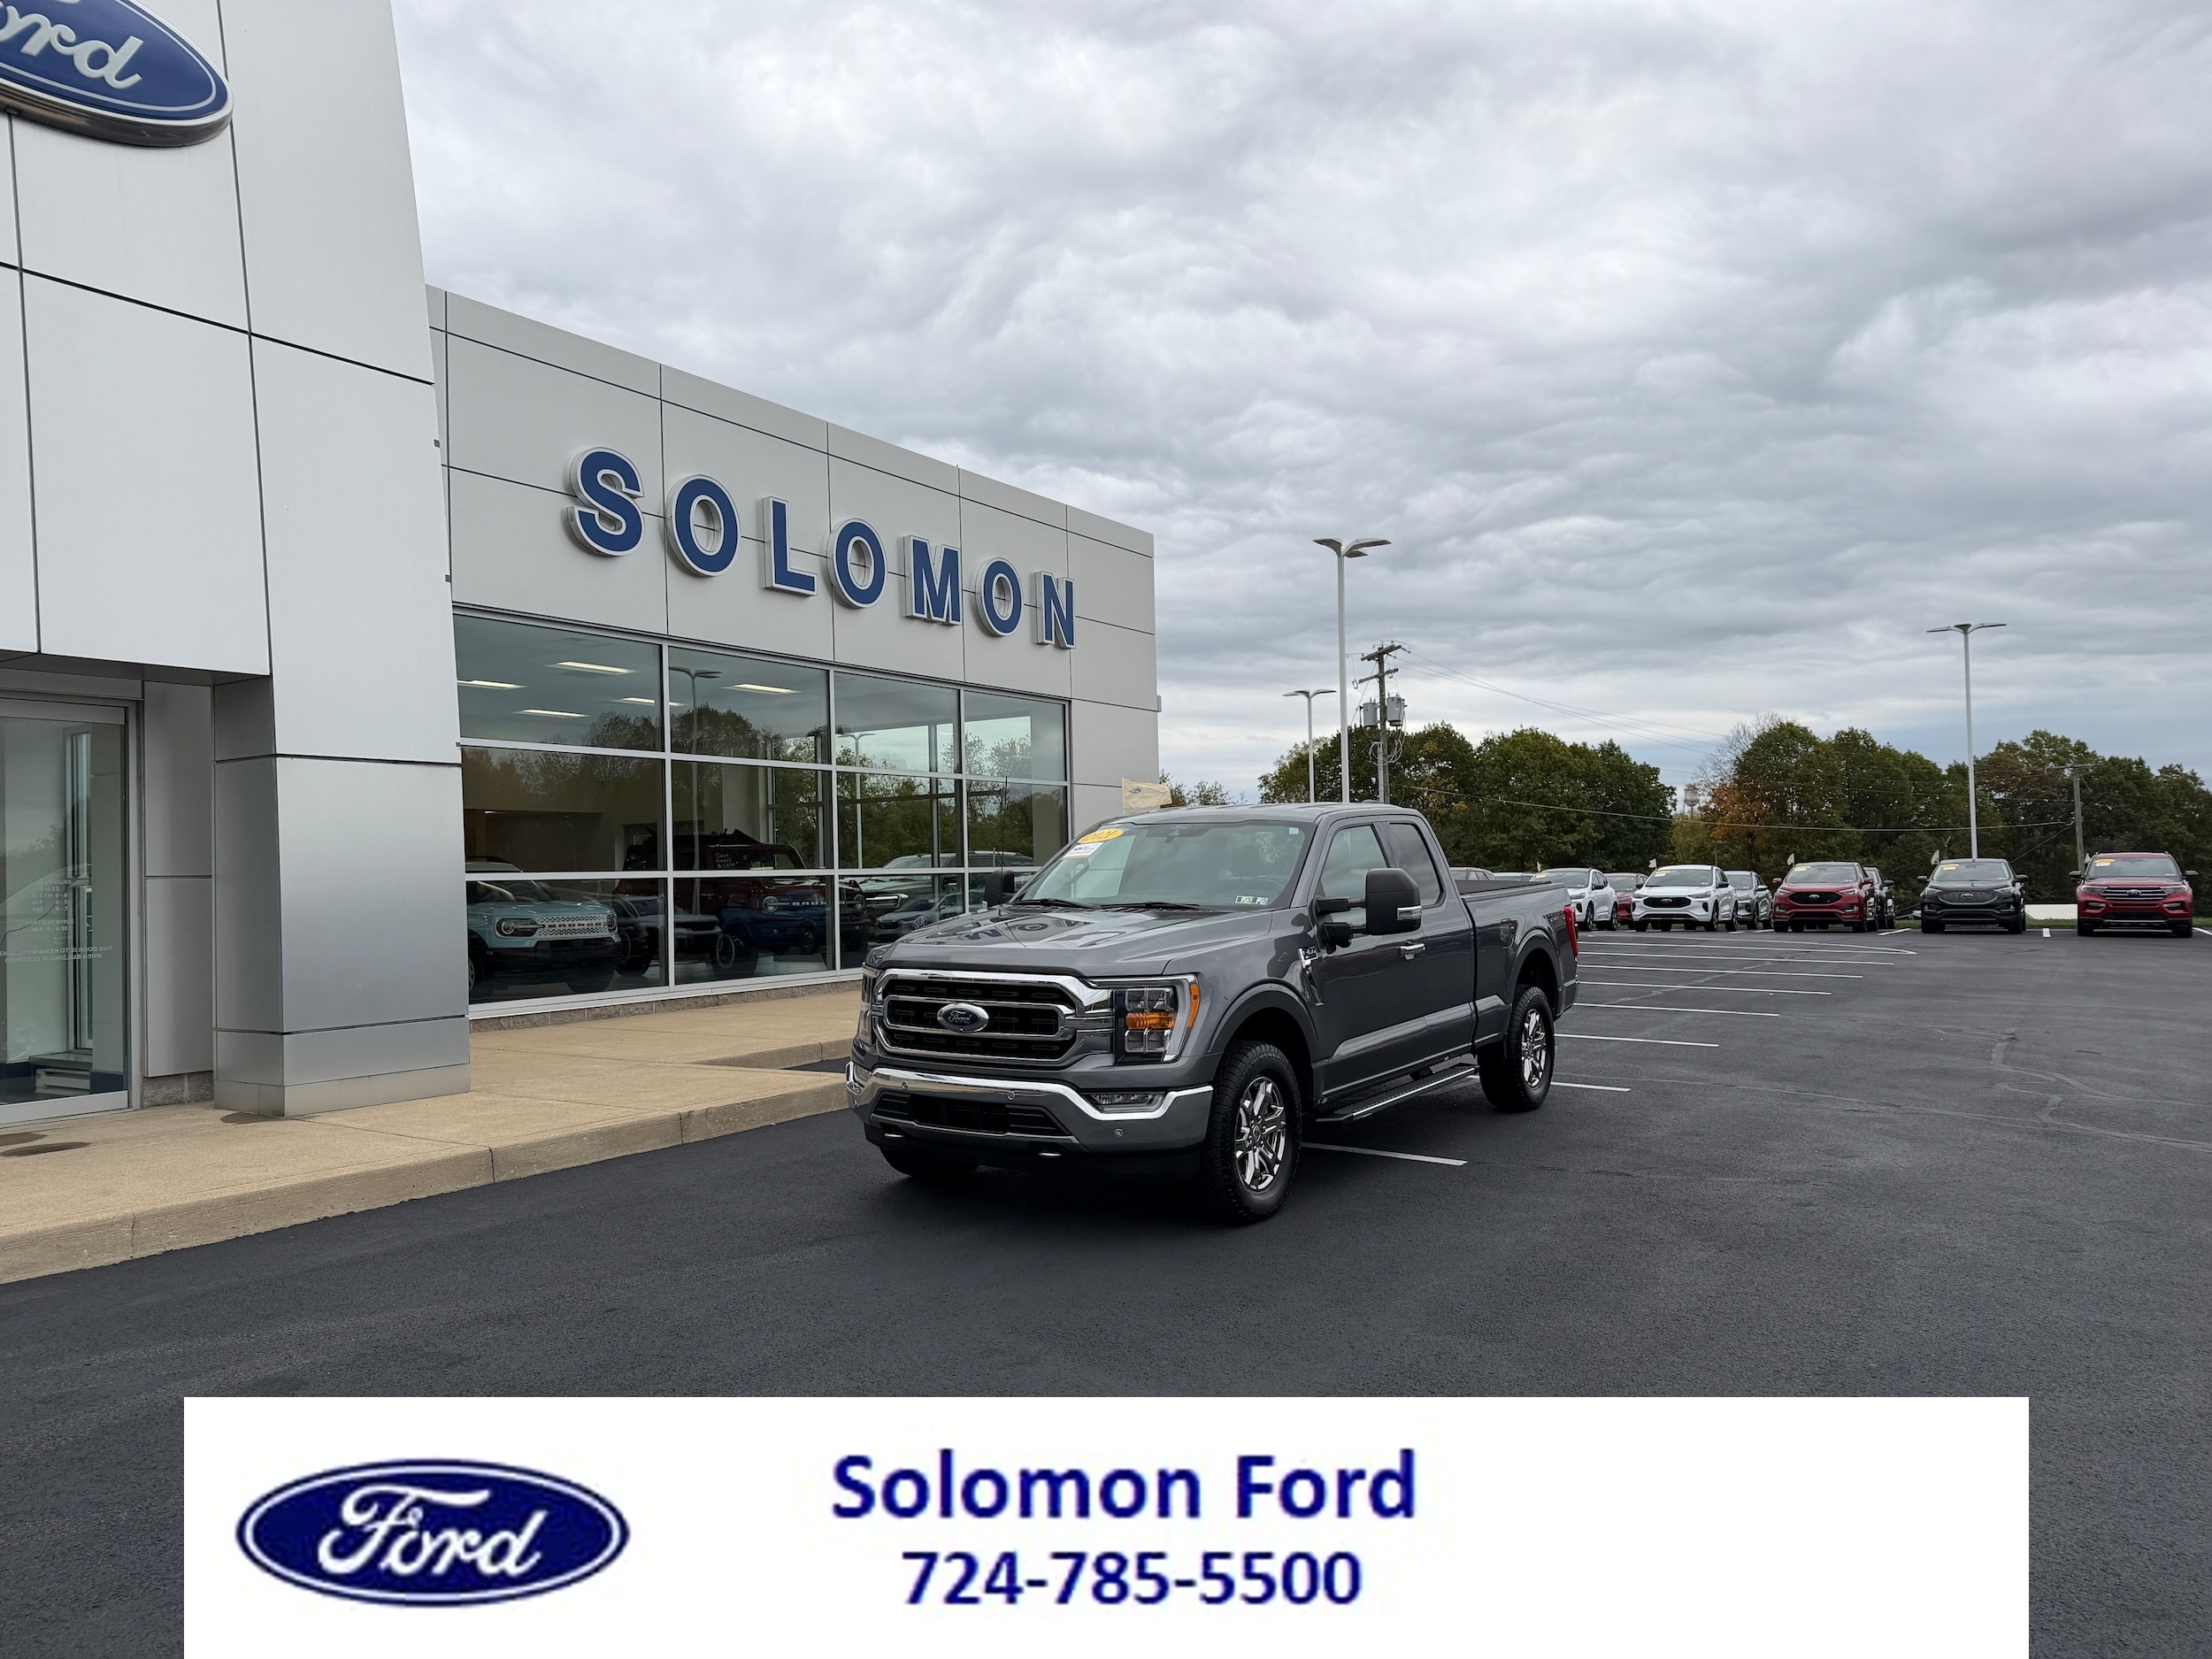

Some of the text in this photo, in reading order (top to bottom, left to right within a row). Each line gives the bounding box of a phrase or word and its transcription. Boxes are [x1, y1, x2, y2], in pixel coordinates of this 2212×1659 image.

[0, 0, 143, 89] ord
[567, 446, 1076, 649] SOLOMON
[948, 1010, 972, 1025] Ford
